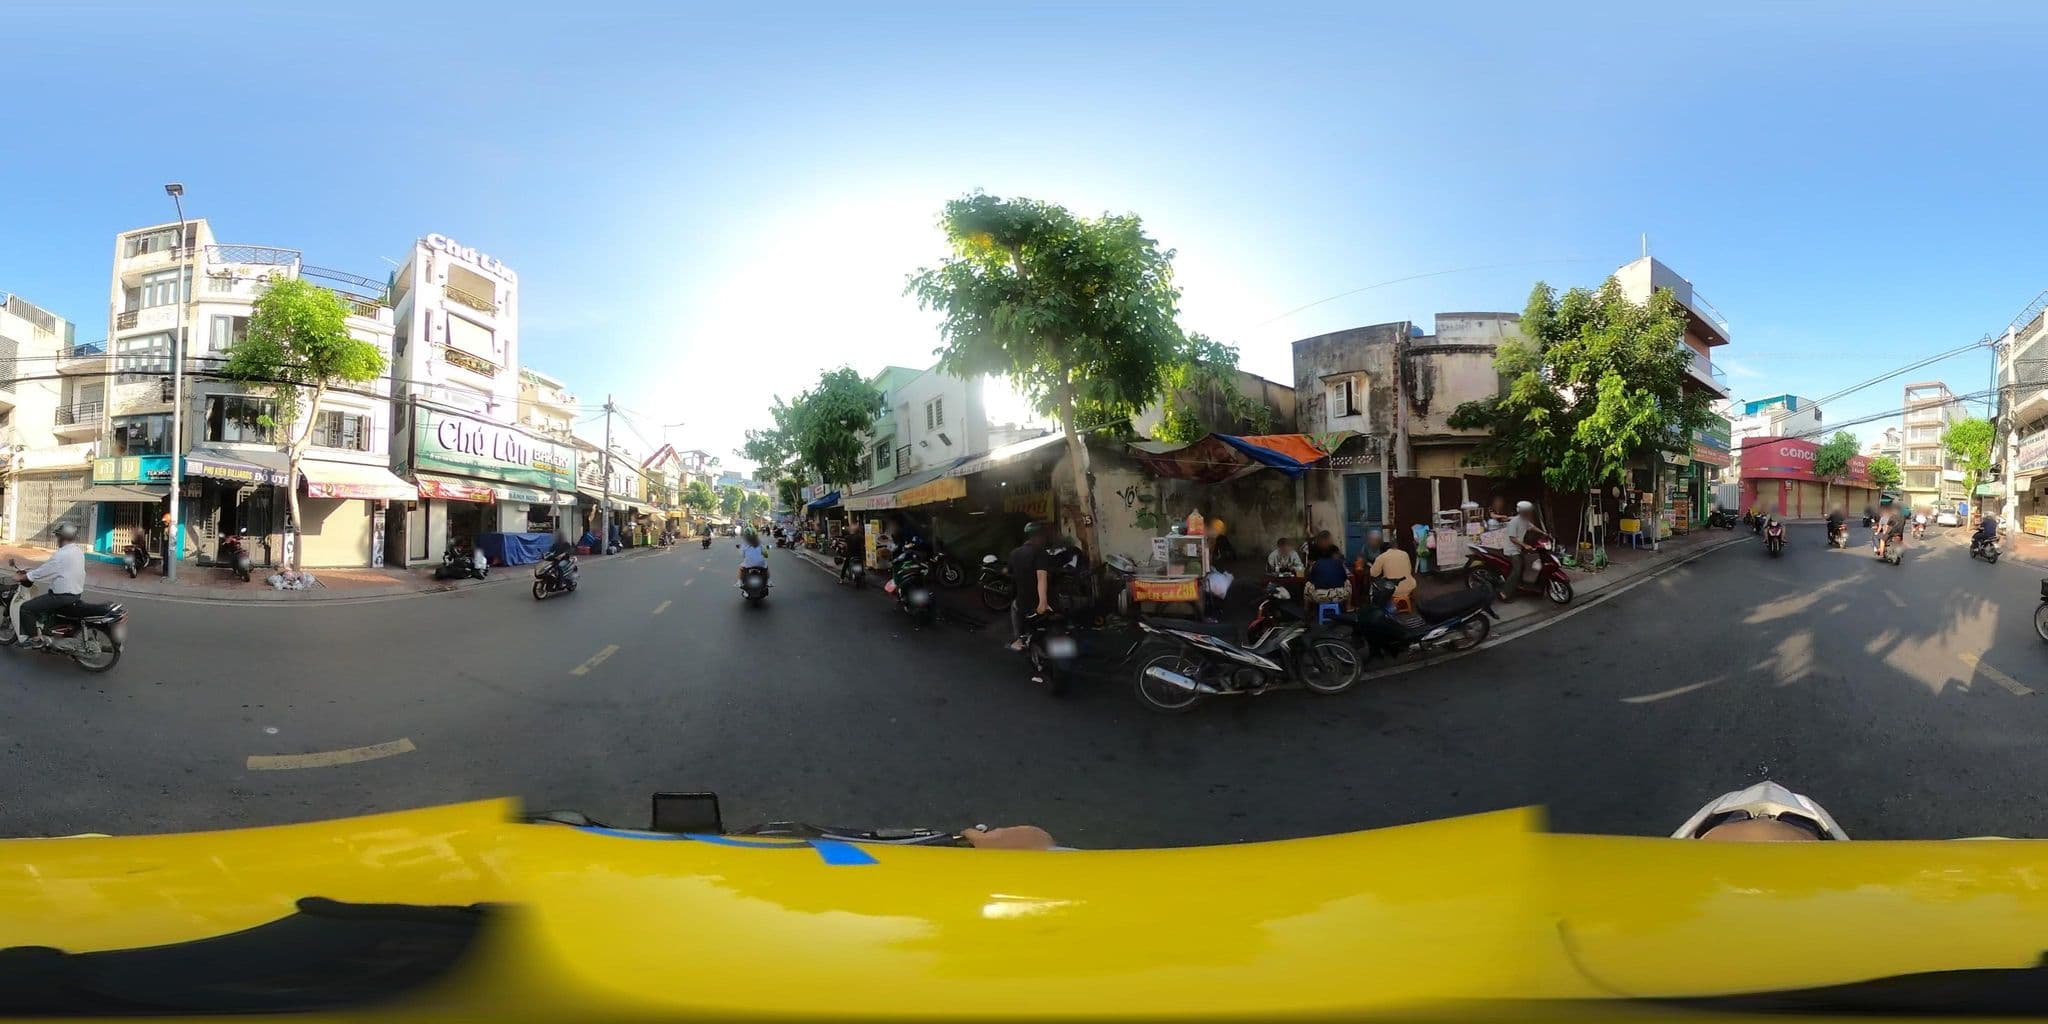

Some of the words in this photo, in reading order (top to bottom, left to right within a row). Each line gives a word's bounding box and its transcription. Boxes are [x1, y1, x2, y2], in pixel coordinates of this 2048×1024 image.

[438, 419, 485, 457] Chú
[493, 432, 530, 466] Lùn
[532, 448, 569, 469] BAKERY
[1780, 447, 1817, 461] concu
